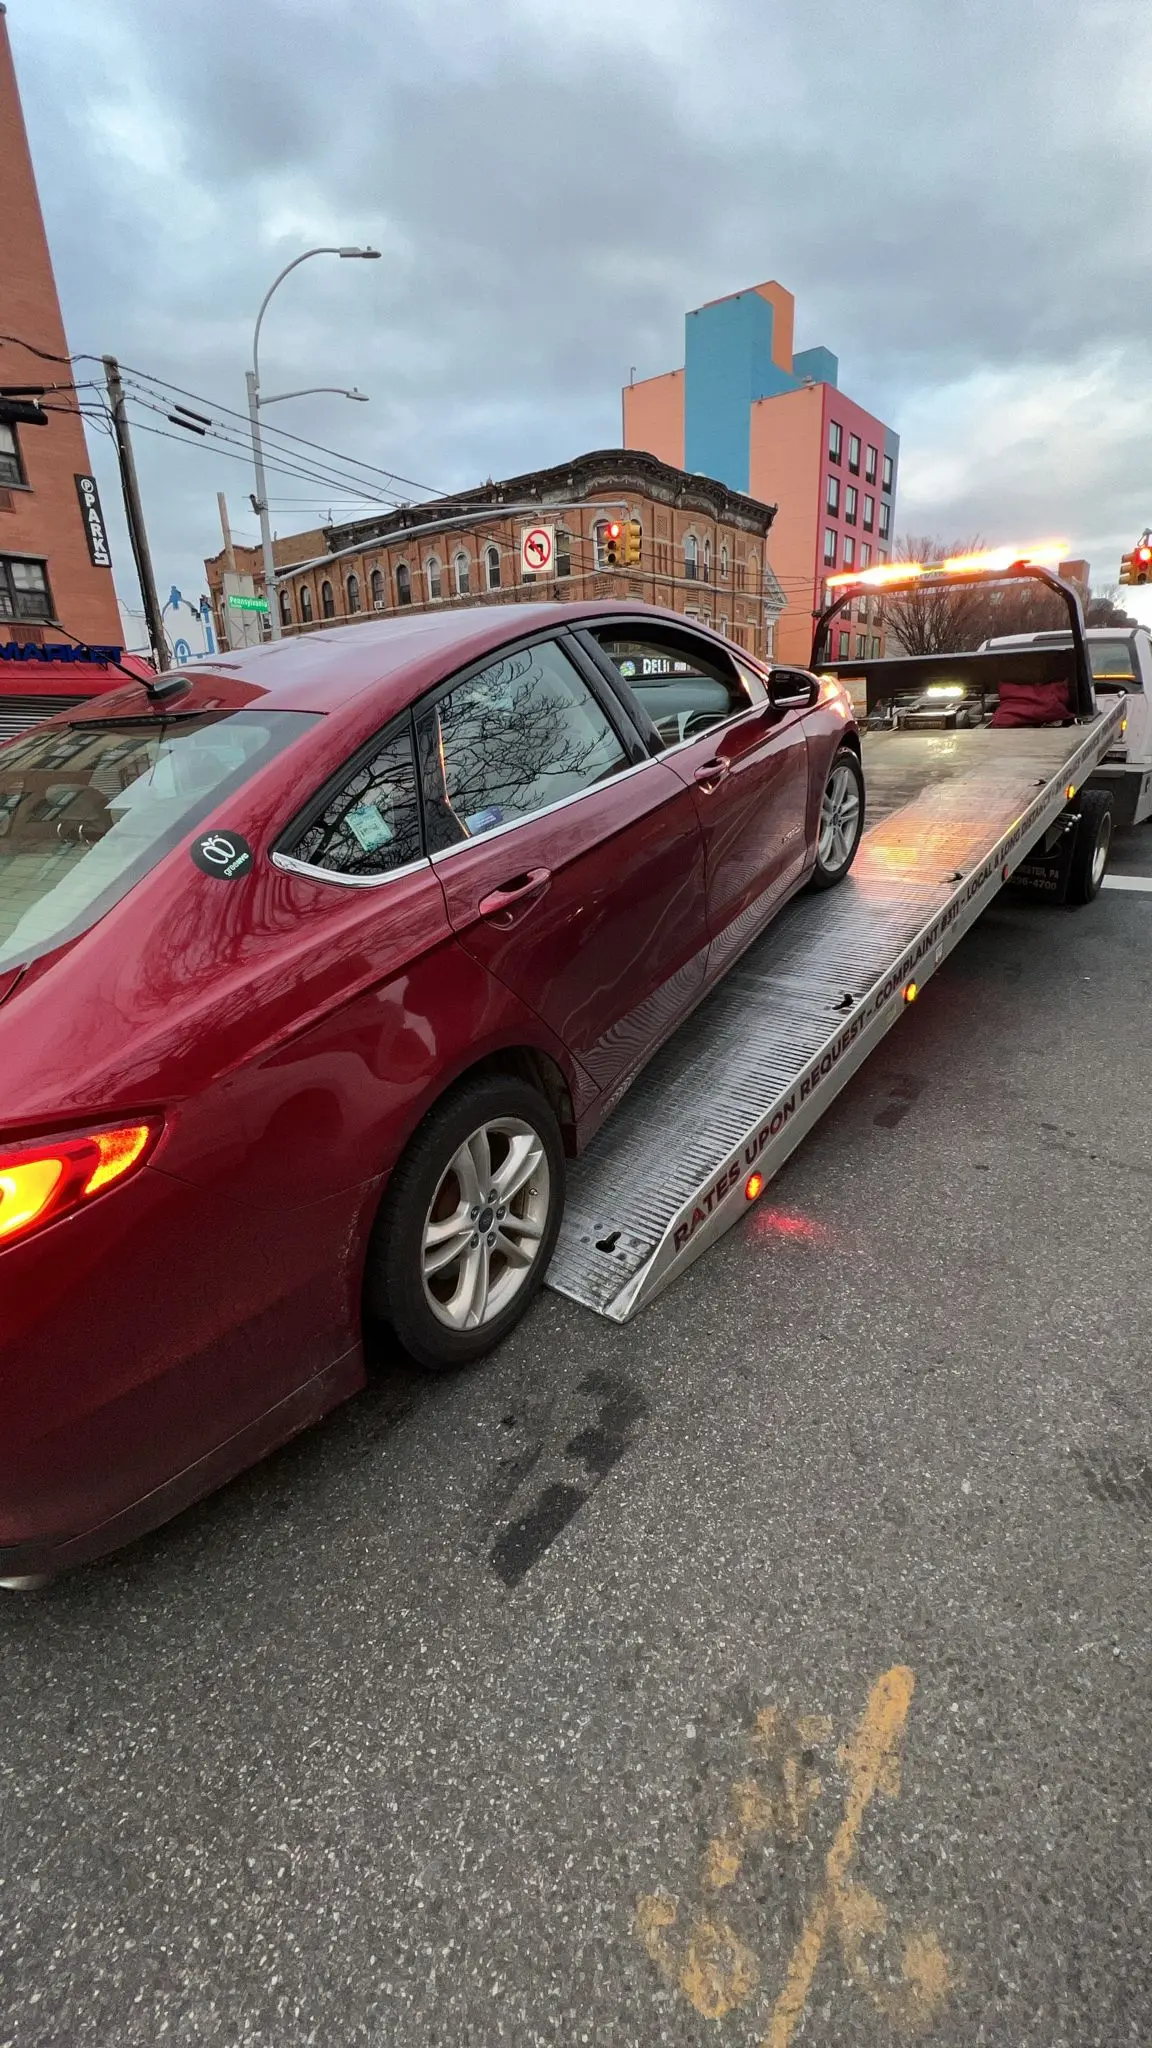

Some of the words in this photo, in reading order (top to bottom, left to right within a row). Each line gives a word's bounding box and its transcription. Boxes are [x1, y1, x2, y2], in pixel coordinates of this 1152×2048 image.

[229, 596, 267, 608] Pennsylvania
[673, 1160, 741, 1253] RATES
[745, 1094, 796, 1165] UPON
[800, 1015, 867, 1101] REQUEST
[876, 925, 939, 1010] COMPLAINT
[967, 863, 993, 899] LOCAL
[1000, 833, 1021, 861] LONG
